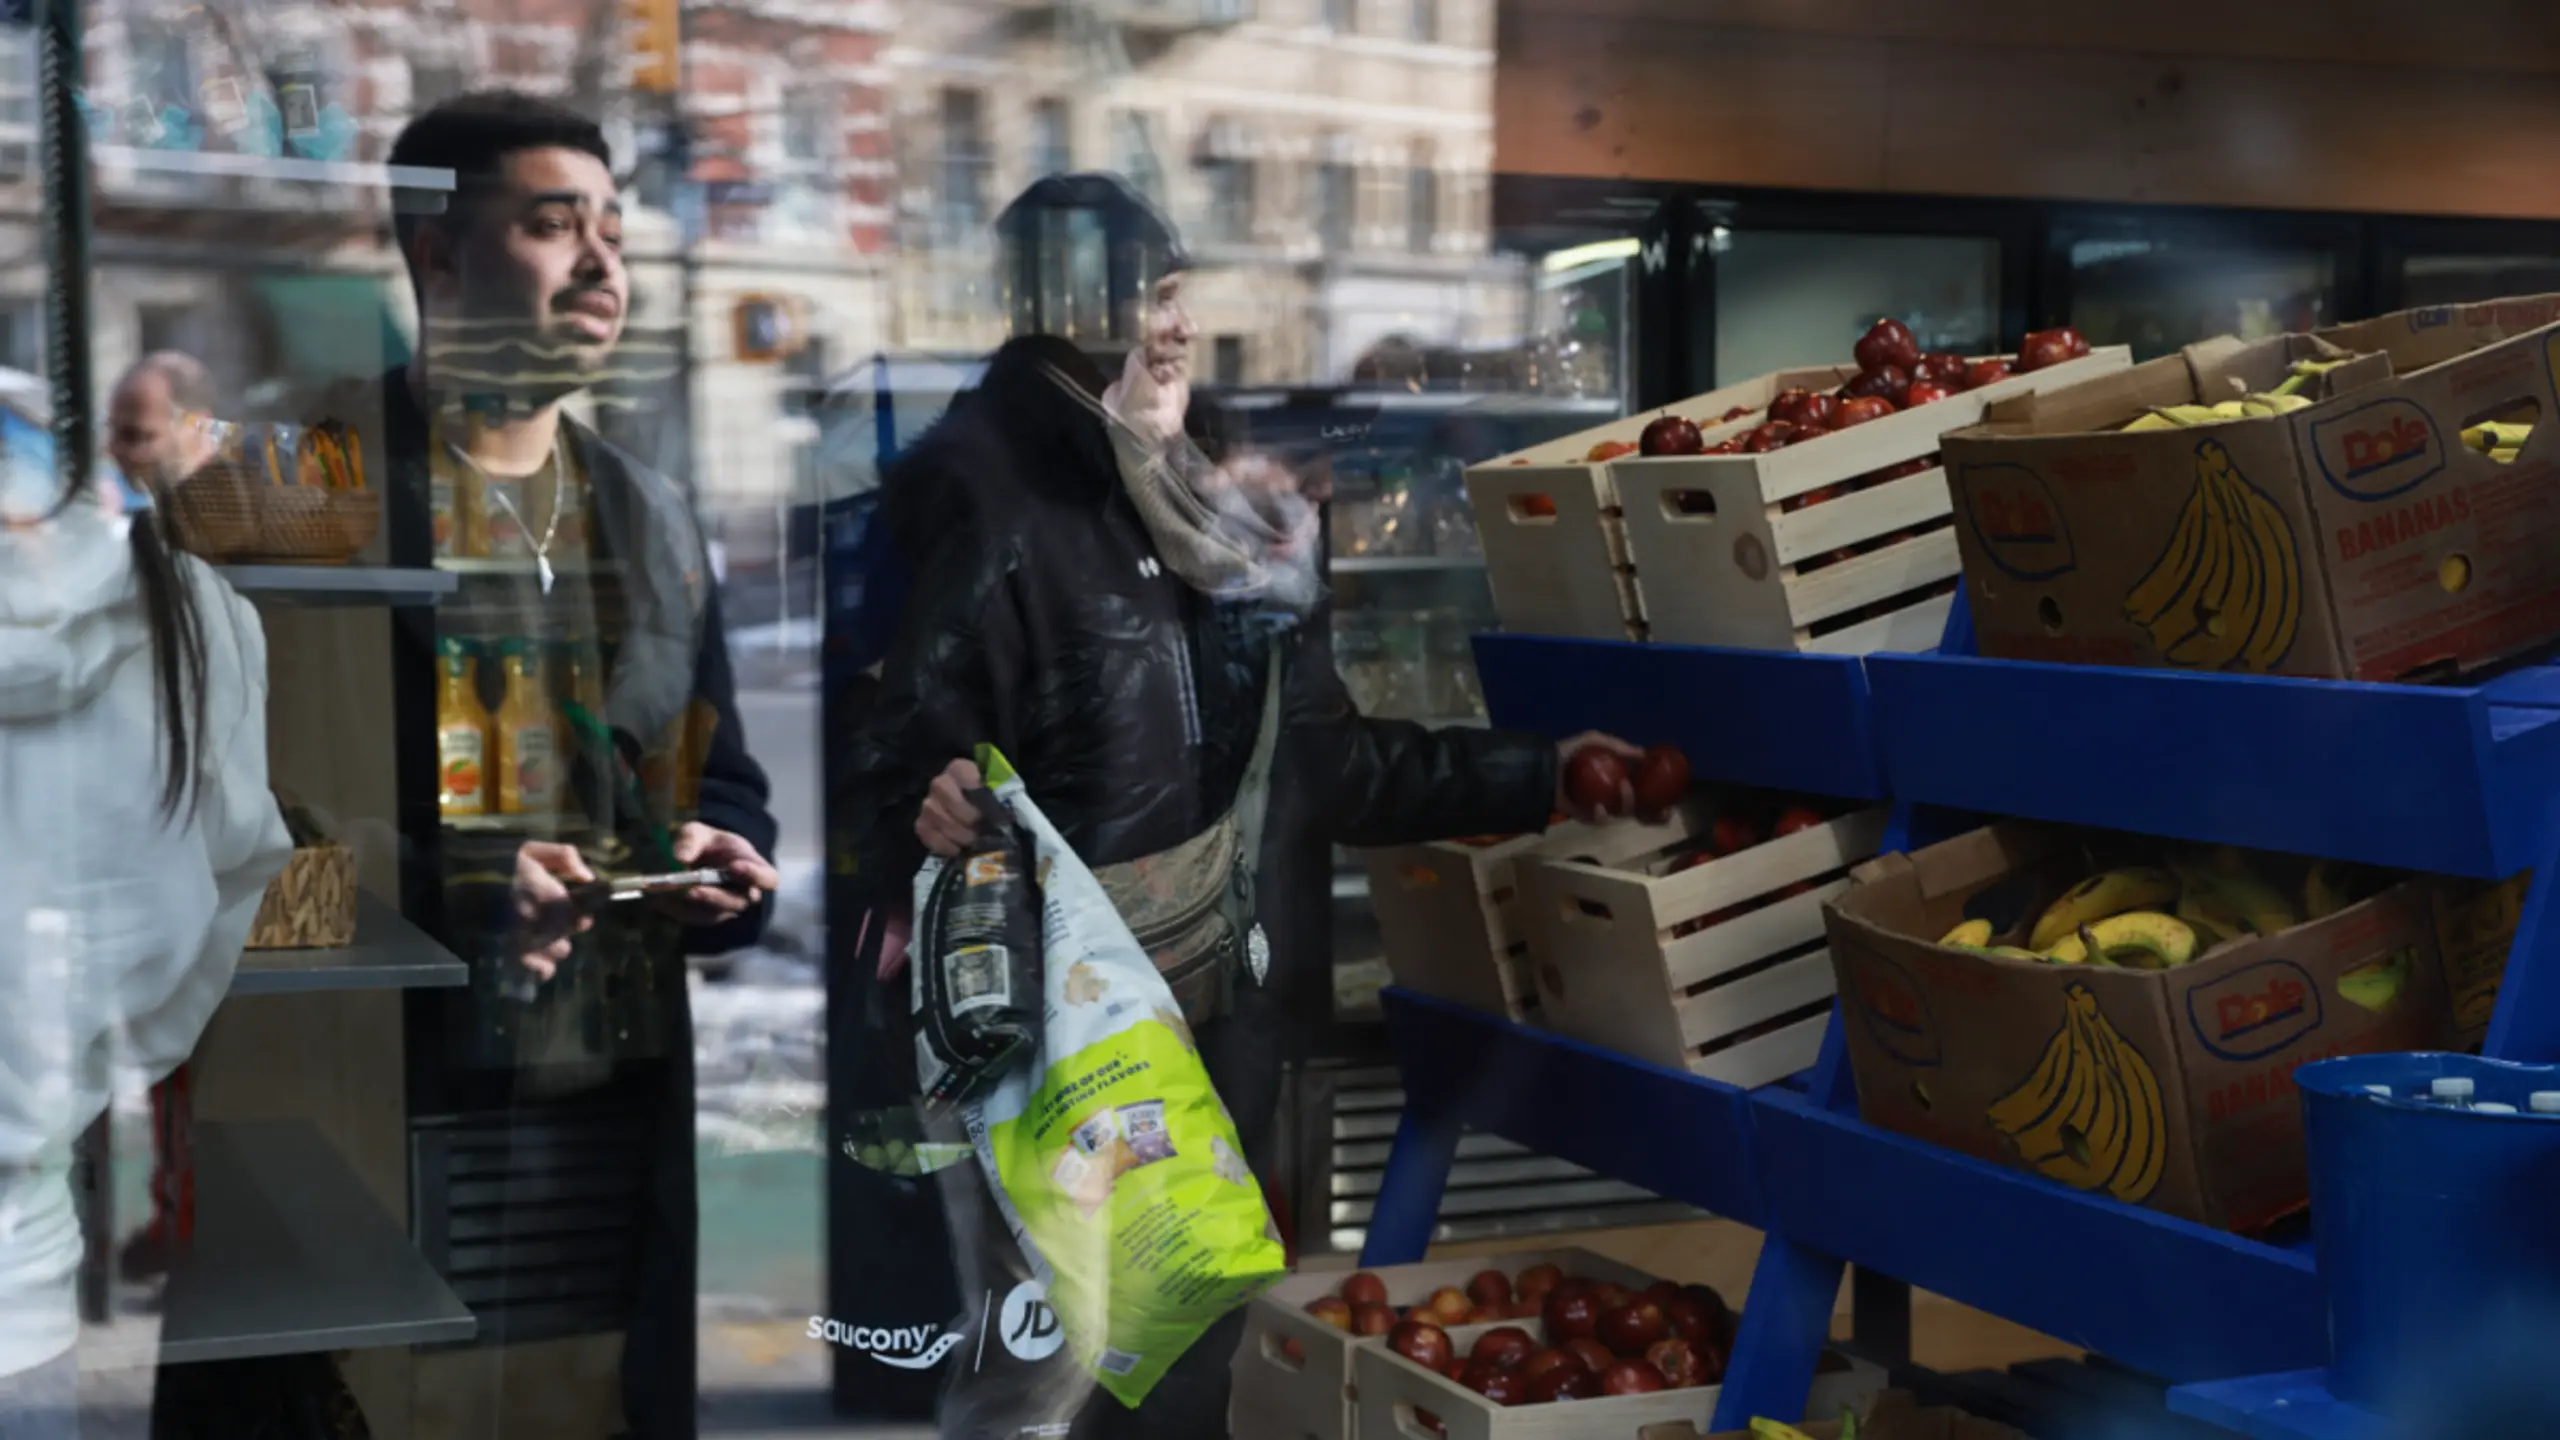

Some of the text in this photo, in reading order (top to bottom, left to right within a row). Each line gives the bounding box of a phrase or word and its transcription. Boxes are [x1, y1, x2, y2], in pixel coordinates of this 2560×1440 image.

[2342, 416, 2428, 470] Dole
[2337, 486, 2470, 562] BANANAS
[2216, 977, 2305, 1036] Dole
[1097, 1059, 1151, 1090] FLAVORS
[1009, 1299, 1061, 1344] JD
